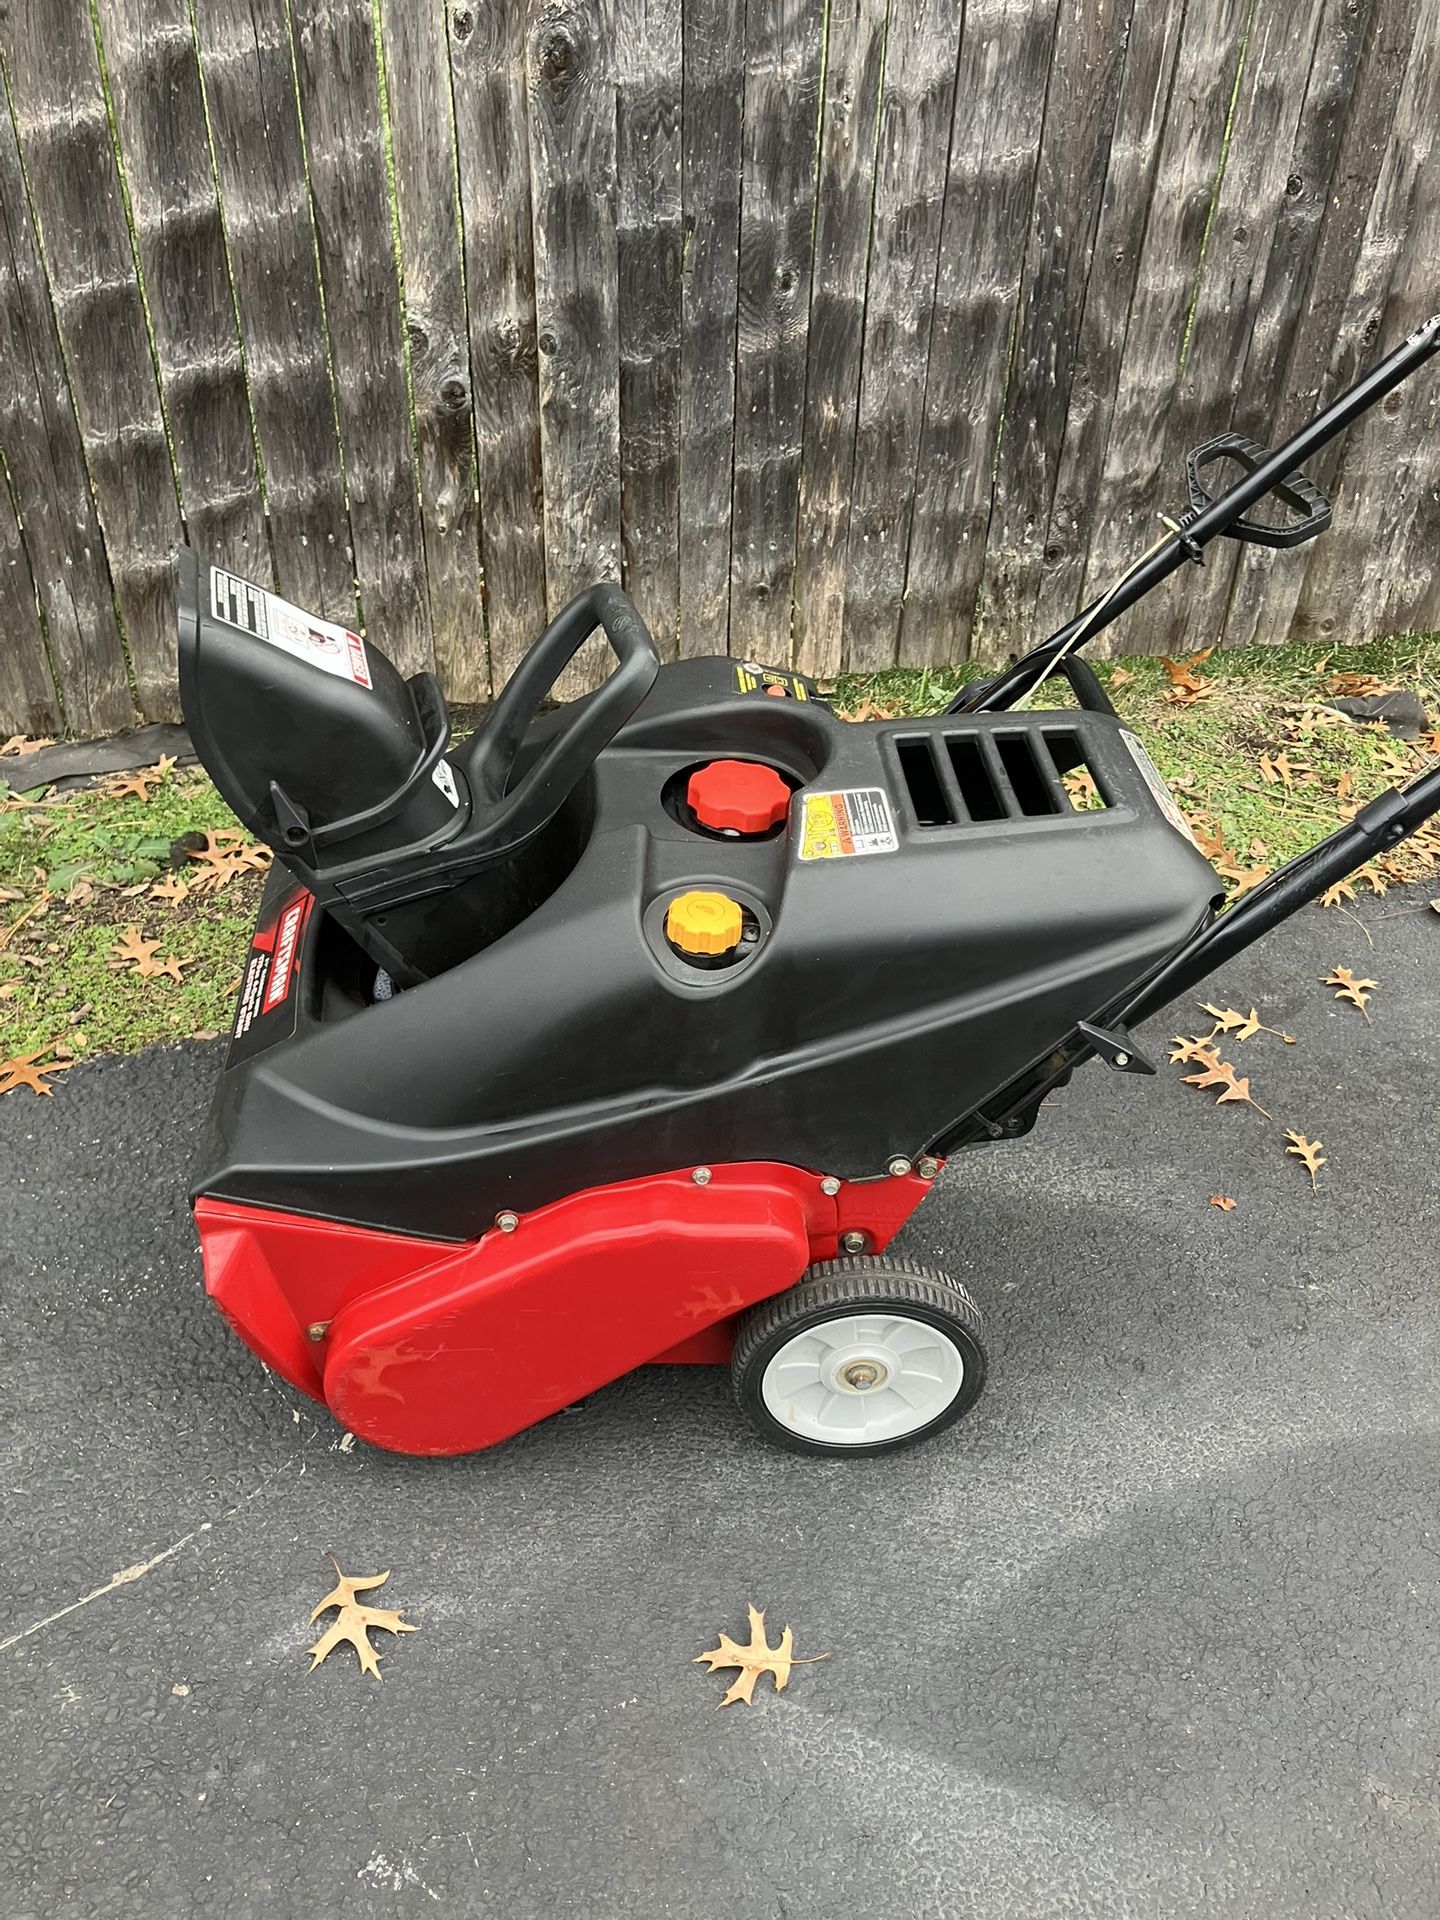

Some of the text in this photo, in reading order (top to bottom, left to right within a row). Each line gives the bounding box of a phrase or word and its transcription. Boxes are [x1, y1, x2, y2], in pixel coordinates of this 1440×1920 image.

[835, 804, 850, 836] WARNING
[268, 906, 301, 1004] CRAFTSMAN
[234, 957, 258, 1039] ELECTRIC START
